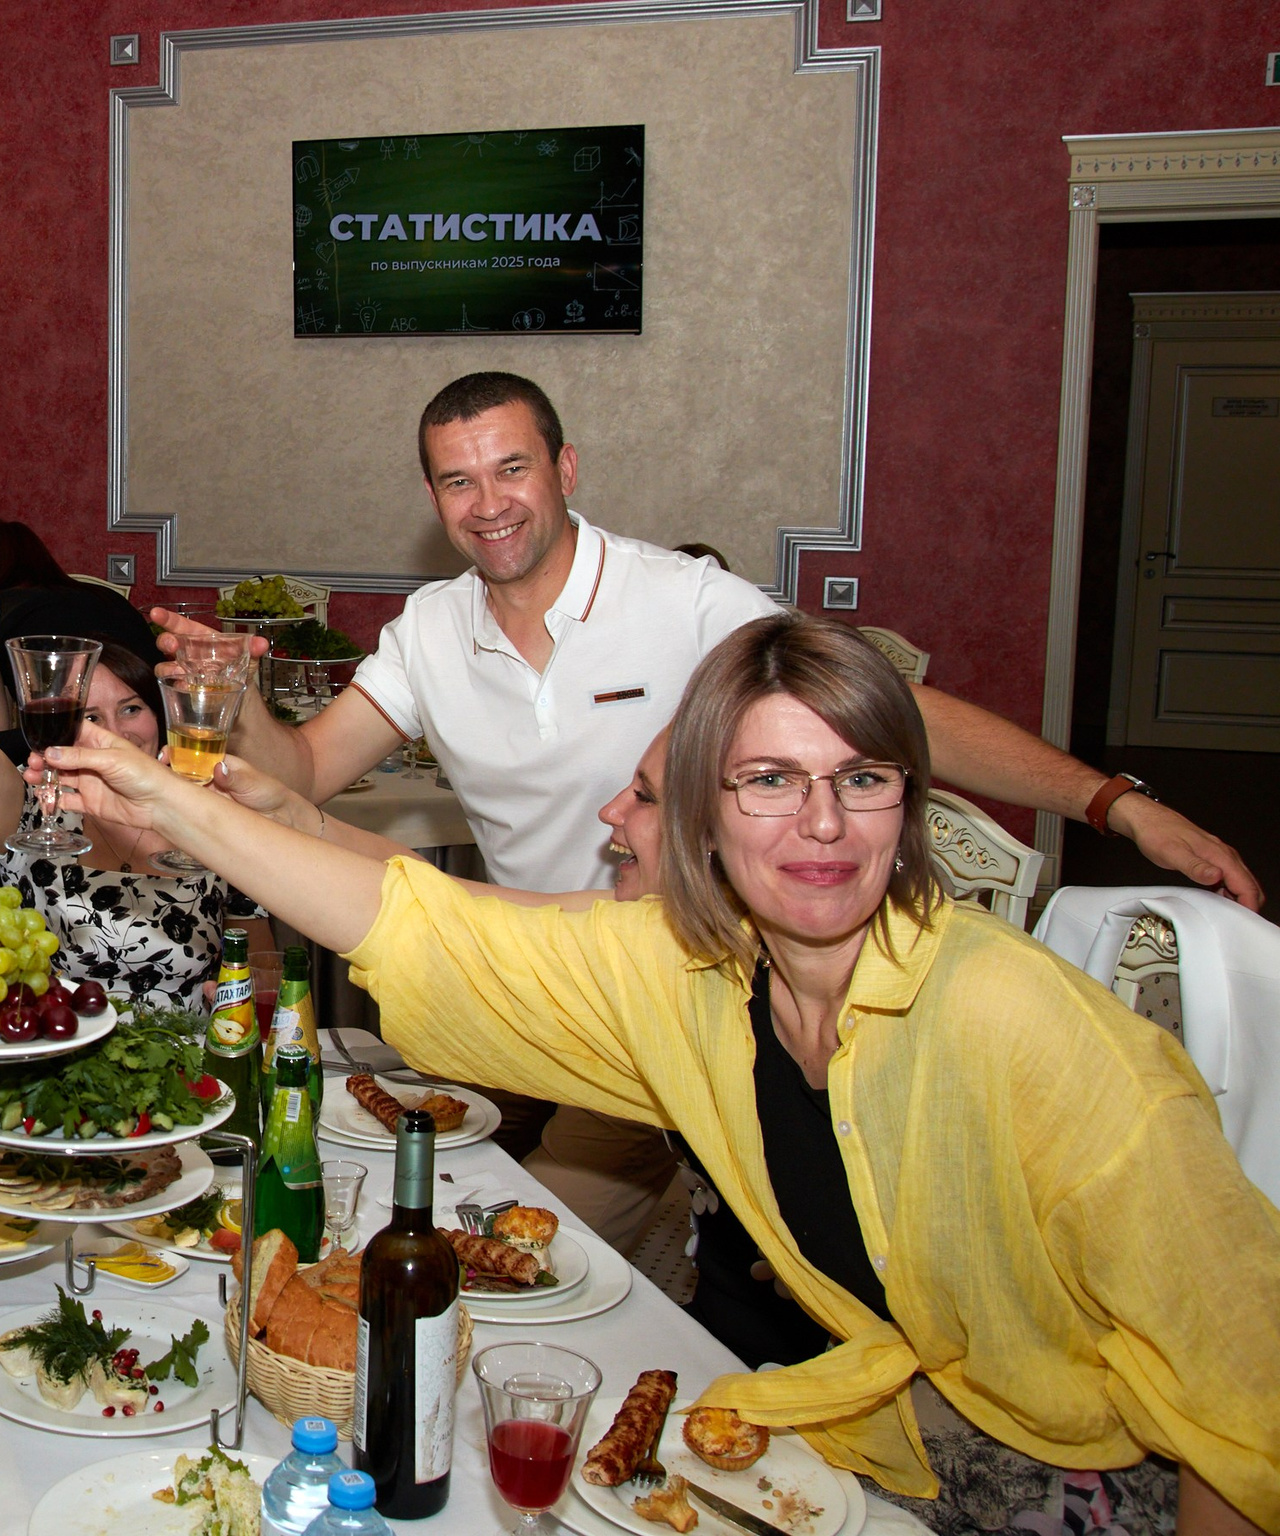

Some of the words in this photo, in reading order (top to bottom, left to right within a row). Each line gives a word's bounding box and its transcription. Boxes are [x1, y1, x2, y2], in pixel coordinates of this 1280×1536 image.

[329, 213, 603, 242] СТАТИСТИКА
[371, 261, 388, 271] по
[392, 259, 488, 273] выпускникам
[491, 256, 524, 268] 2025
[528, 256, 561, 269] года
[390, 317, 417, 331] ABC
[216, 983, 252, 1003] АТАХТАРИ
